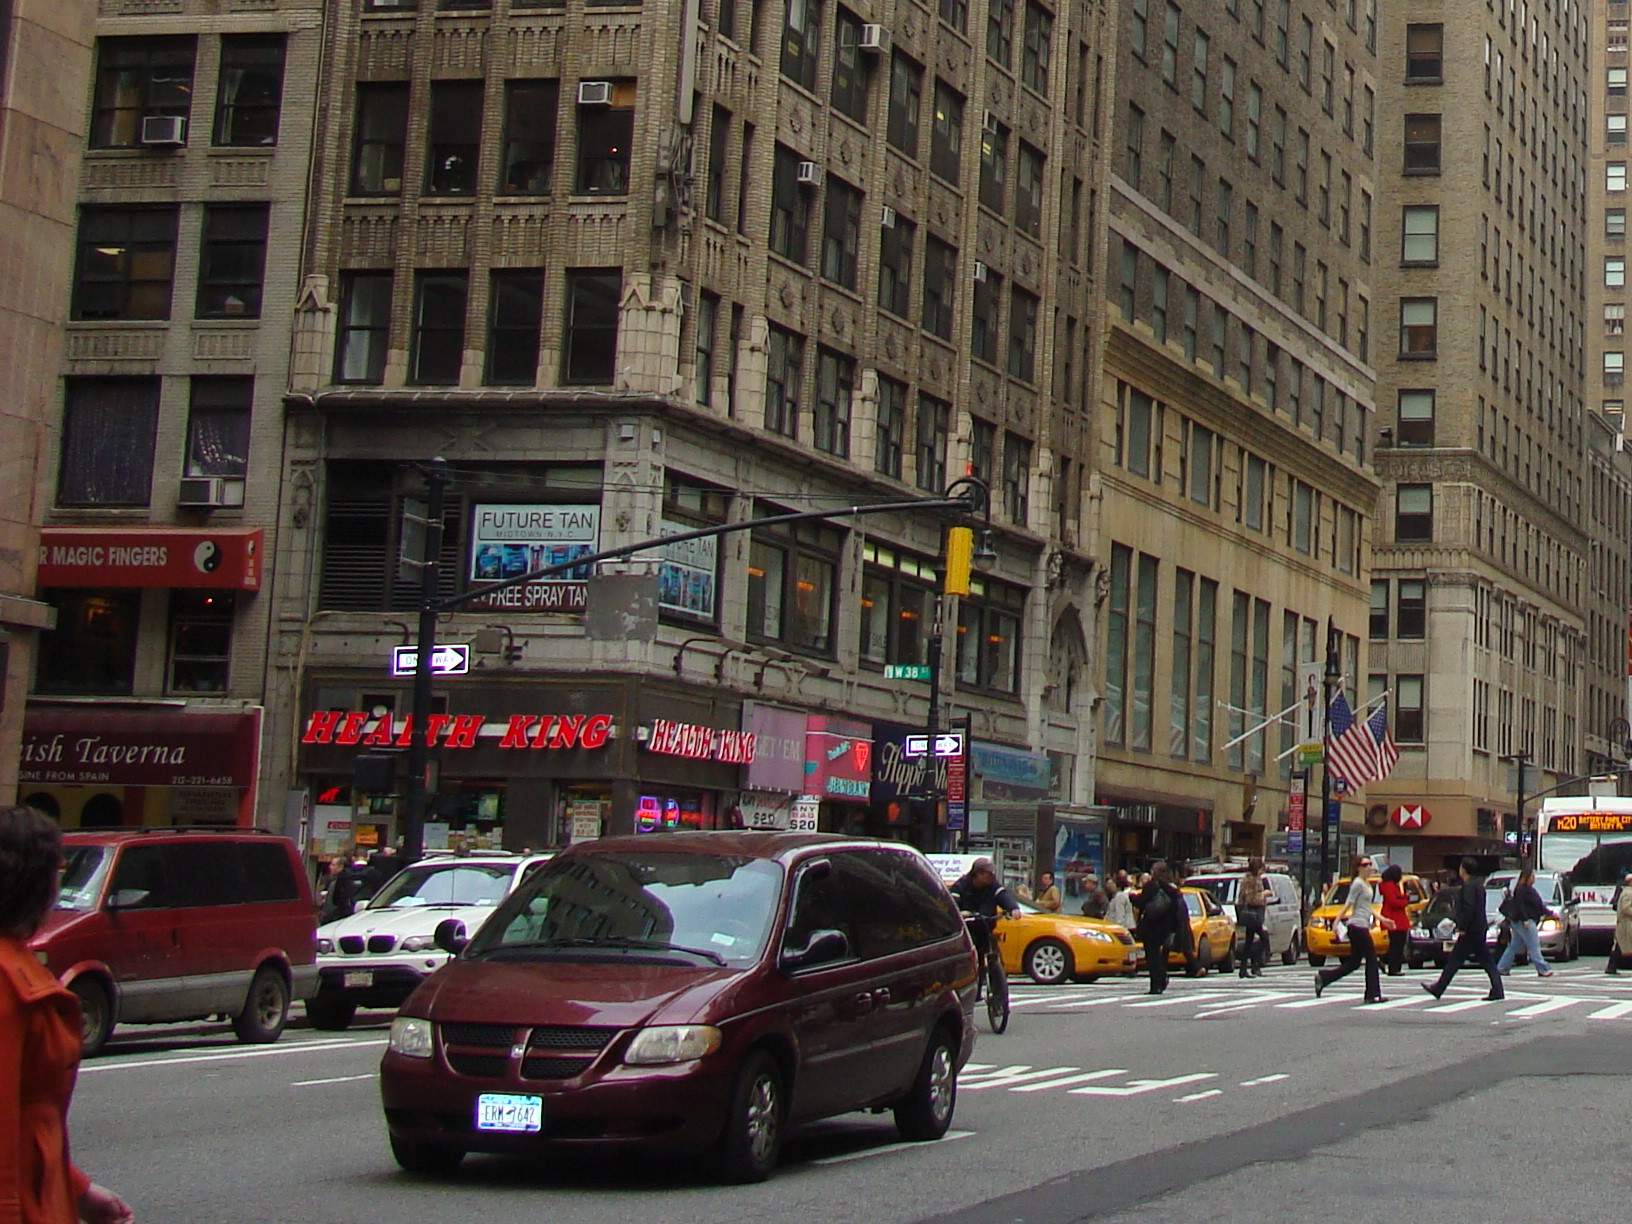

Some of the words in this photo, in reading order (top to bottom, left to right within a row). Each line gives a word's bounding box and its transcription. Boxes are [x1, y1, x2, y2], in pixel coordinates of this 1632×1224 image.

[482, 511, 554, 528] FUTURE
[559, 512, 593, 528] TAN
[53, 546, 104, 566] MAGIC
[109, 546, 168, 566] FINGERS
[489, 585, 522, 605] FREE
[525, 585, 565, 605] SPRAY
[895, 666, 904, 678] W
[905, 666, 919, 679] 38
[302, 711, 486, 748] HEALTH
[500, 714, 613, 749] KING
[76, 735, 186, 765] Taverna
[649, 718, 715, 761] HEALTH
[717, 728, 757, 764] KING
[46, 772, 75, 781] FROM
[80, 772, 109, 781] SPAIN
[1579, 816, 1604, 824] BATTERY
[1604, 816, 1620, 824] PARK
